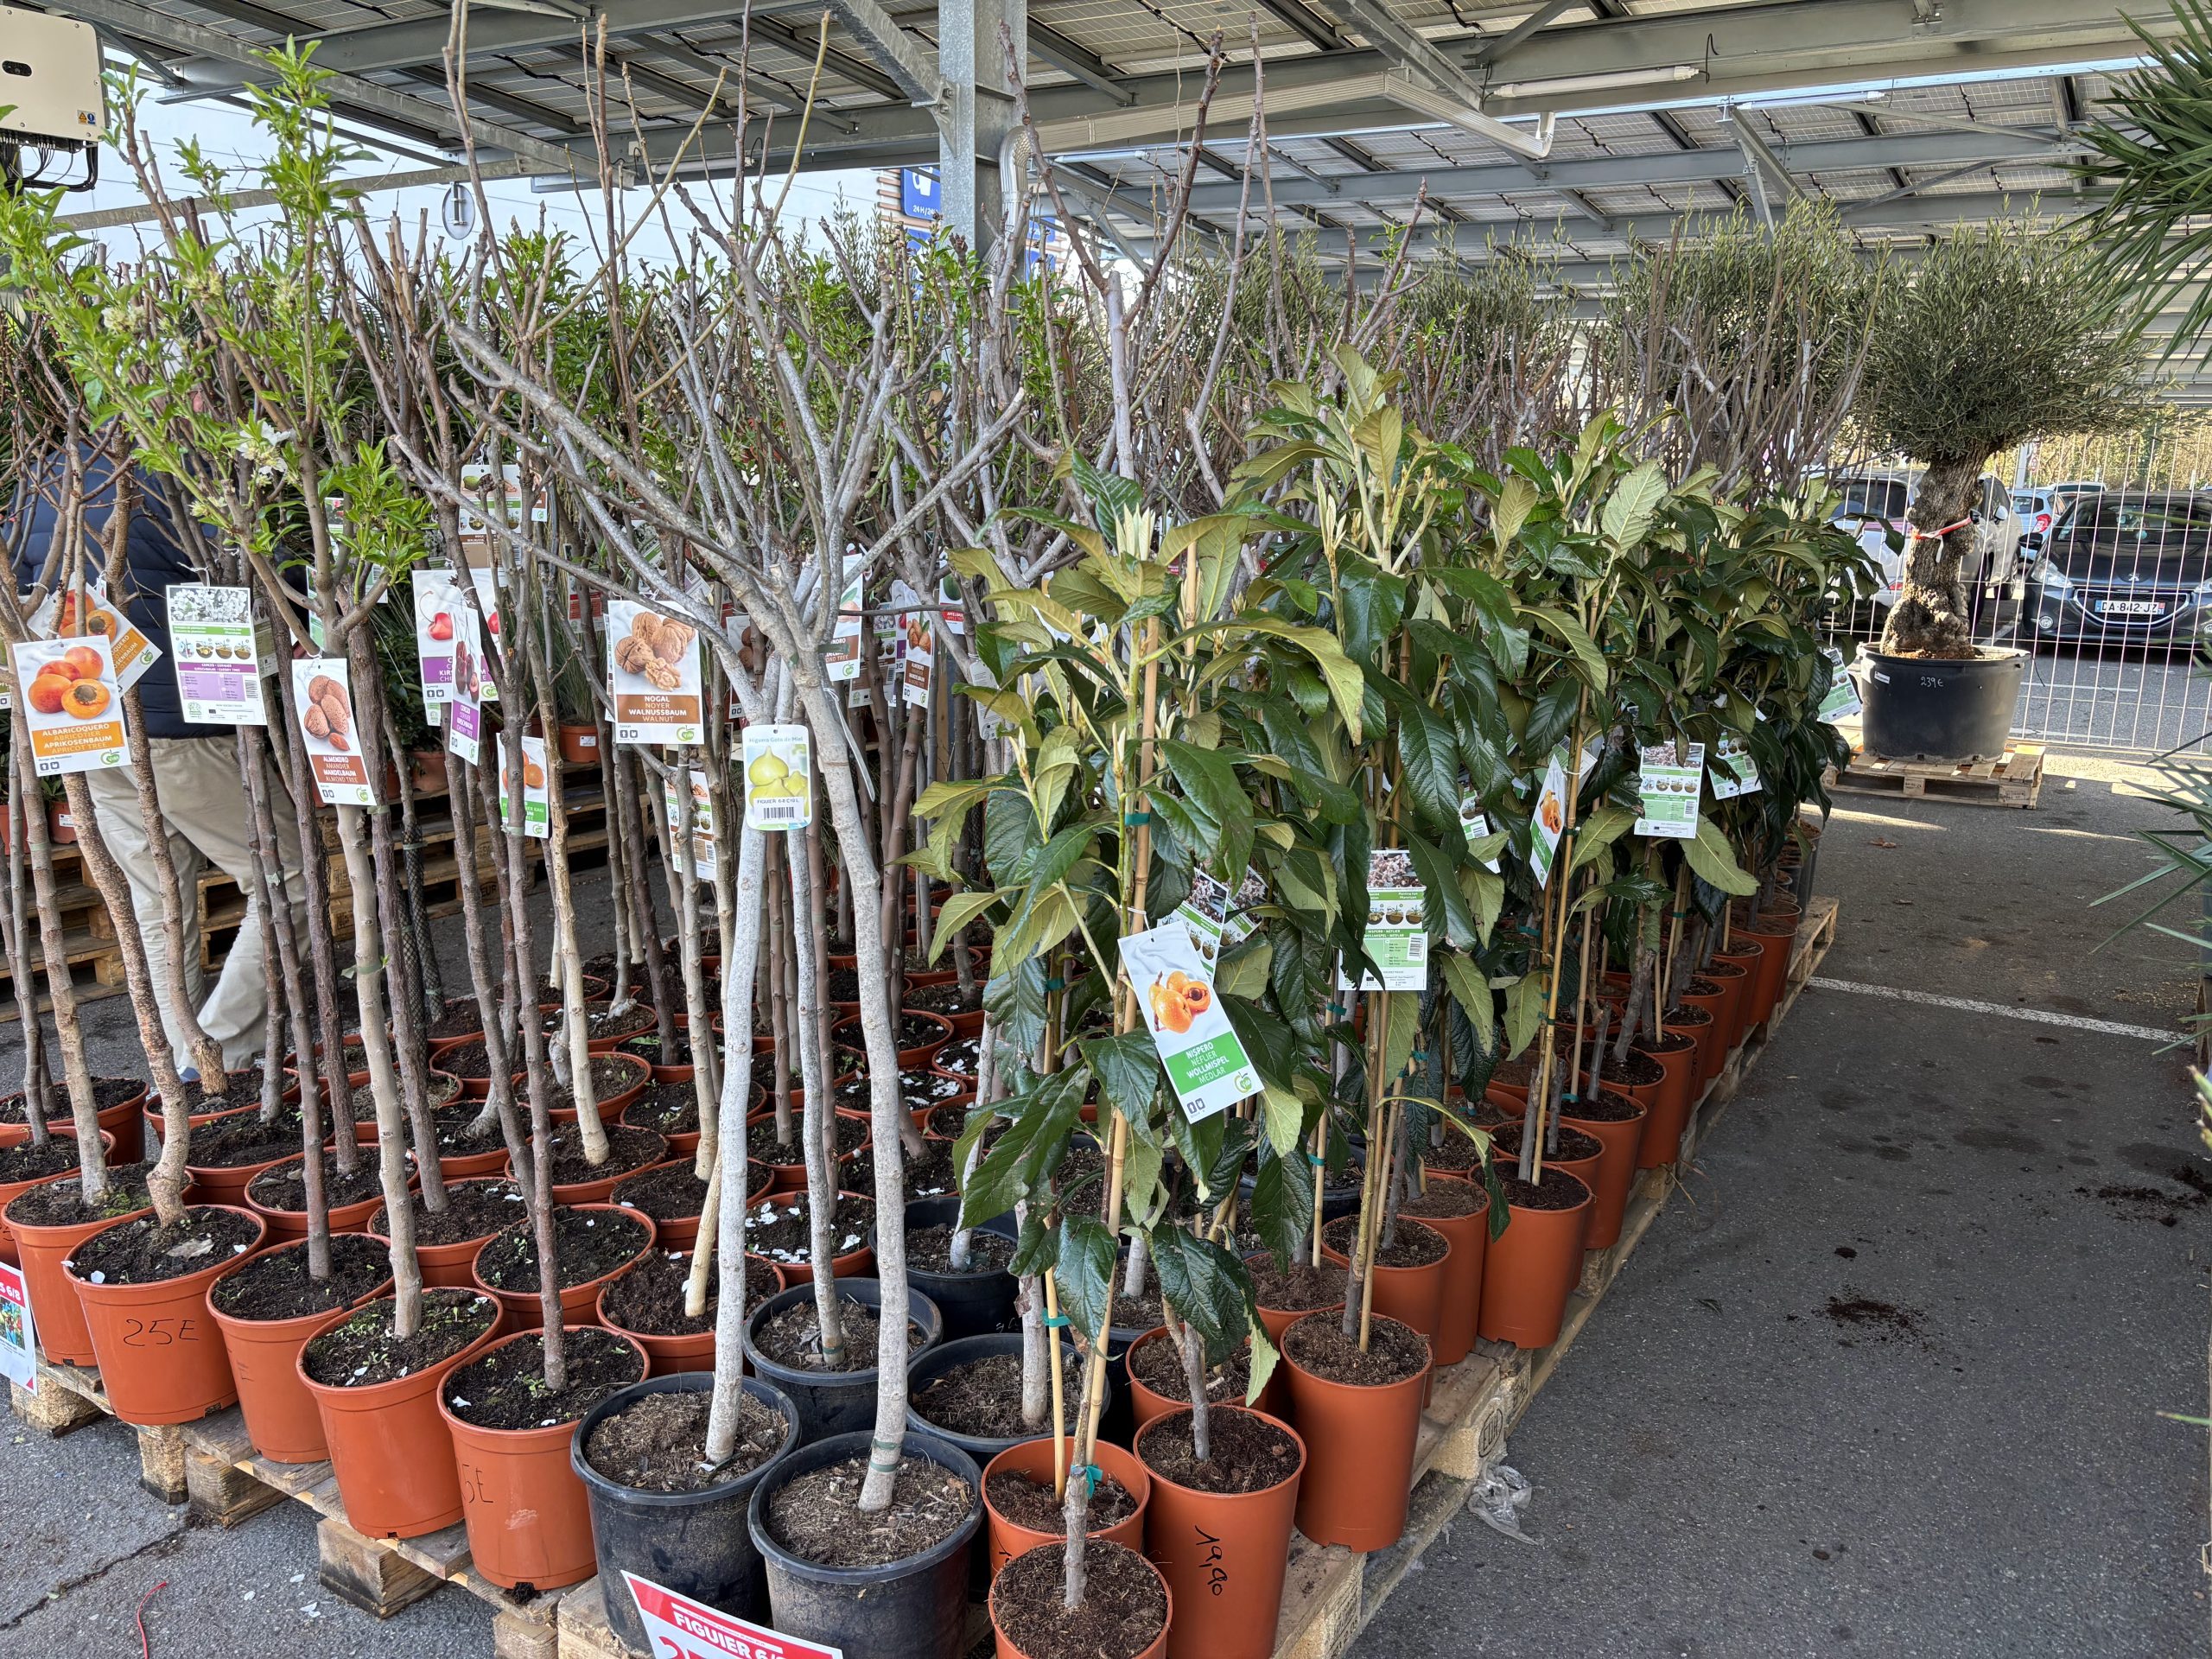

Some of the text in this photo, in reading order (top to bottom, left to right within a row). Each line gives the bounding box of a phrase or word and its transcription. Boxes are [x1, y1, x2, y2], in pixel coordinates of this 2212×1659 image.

[42, 723, 110, 737] ALBARICOQUERO
[54, 731, 101, 741] ABRICOTIER
[44, 735, 112, 749] APRIKOSENBAUM
[52, 745, 87, 754] APRICOT
[1185, 1041, 1214, 1059] NISPERO
[1185, 1055, 1230, 1078] WOLLMISPEL
[1198, 1066, 1226, 1084] MEDLAR
[6, 1285, 22, 1301] 6/8
[673, 1610, 753, 1659] FIGUIER
